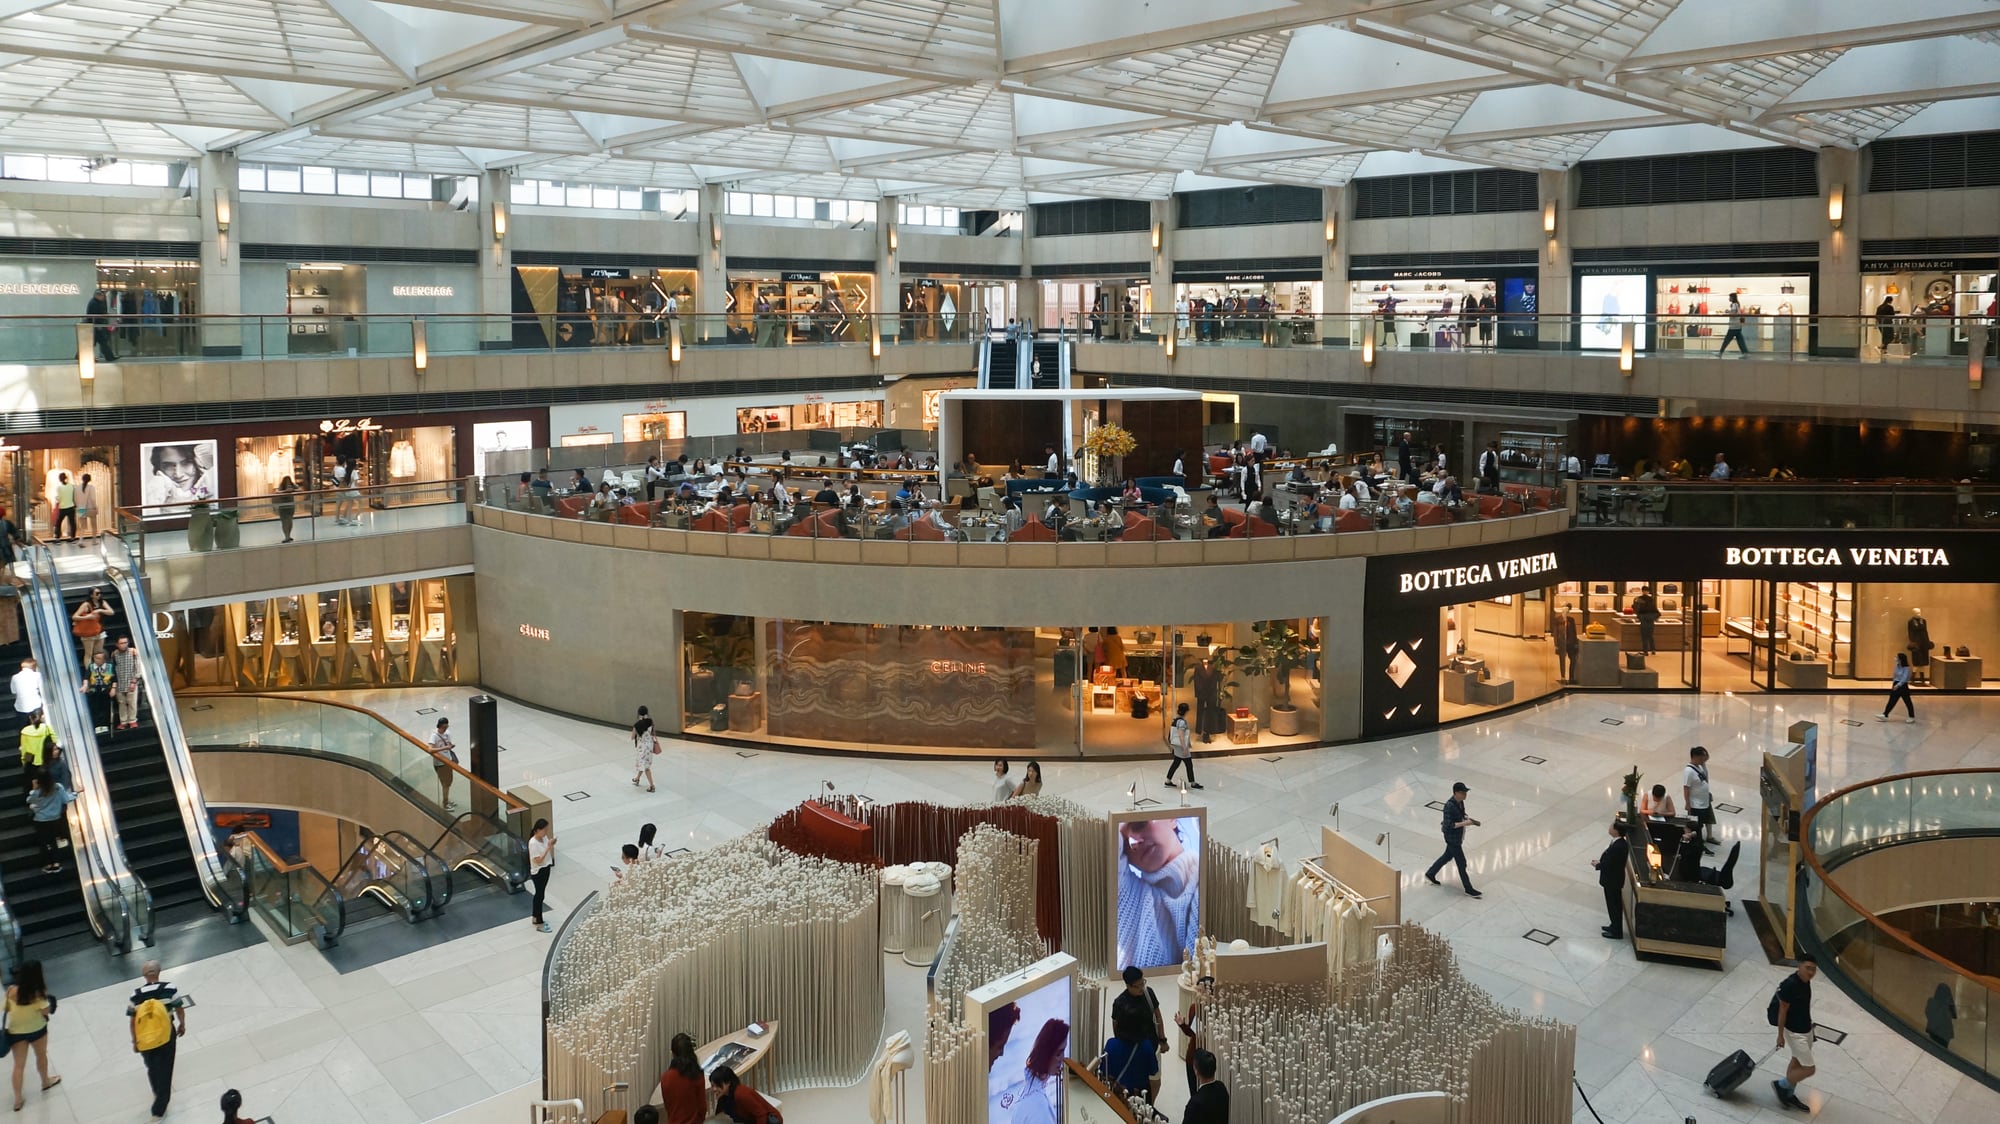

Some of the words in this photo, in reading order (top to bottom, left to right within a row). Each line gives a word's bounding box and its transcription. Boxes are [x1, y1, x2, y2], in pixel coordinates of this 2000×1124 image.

[393, 286, 454, 296] BALENCIAGA
[1725, 547, 1842, 566] BOTTEGA
[1850, 548, 1950, 566] VENETA
[1399, 564, 1492, 593] BOTTEGA
[1497, 552, 1558, 580] VENETA
